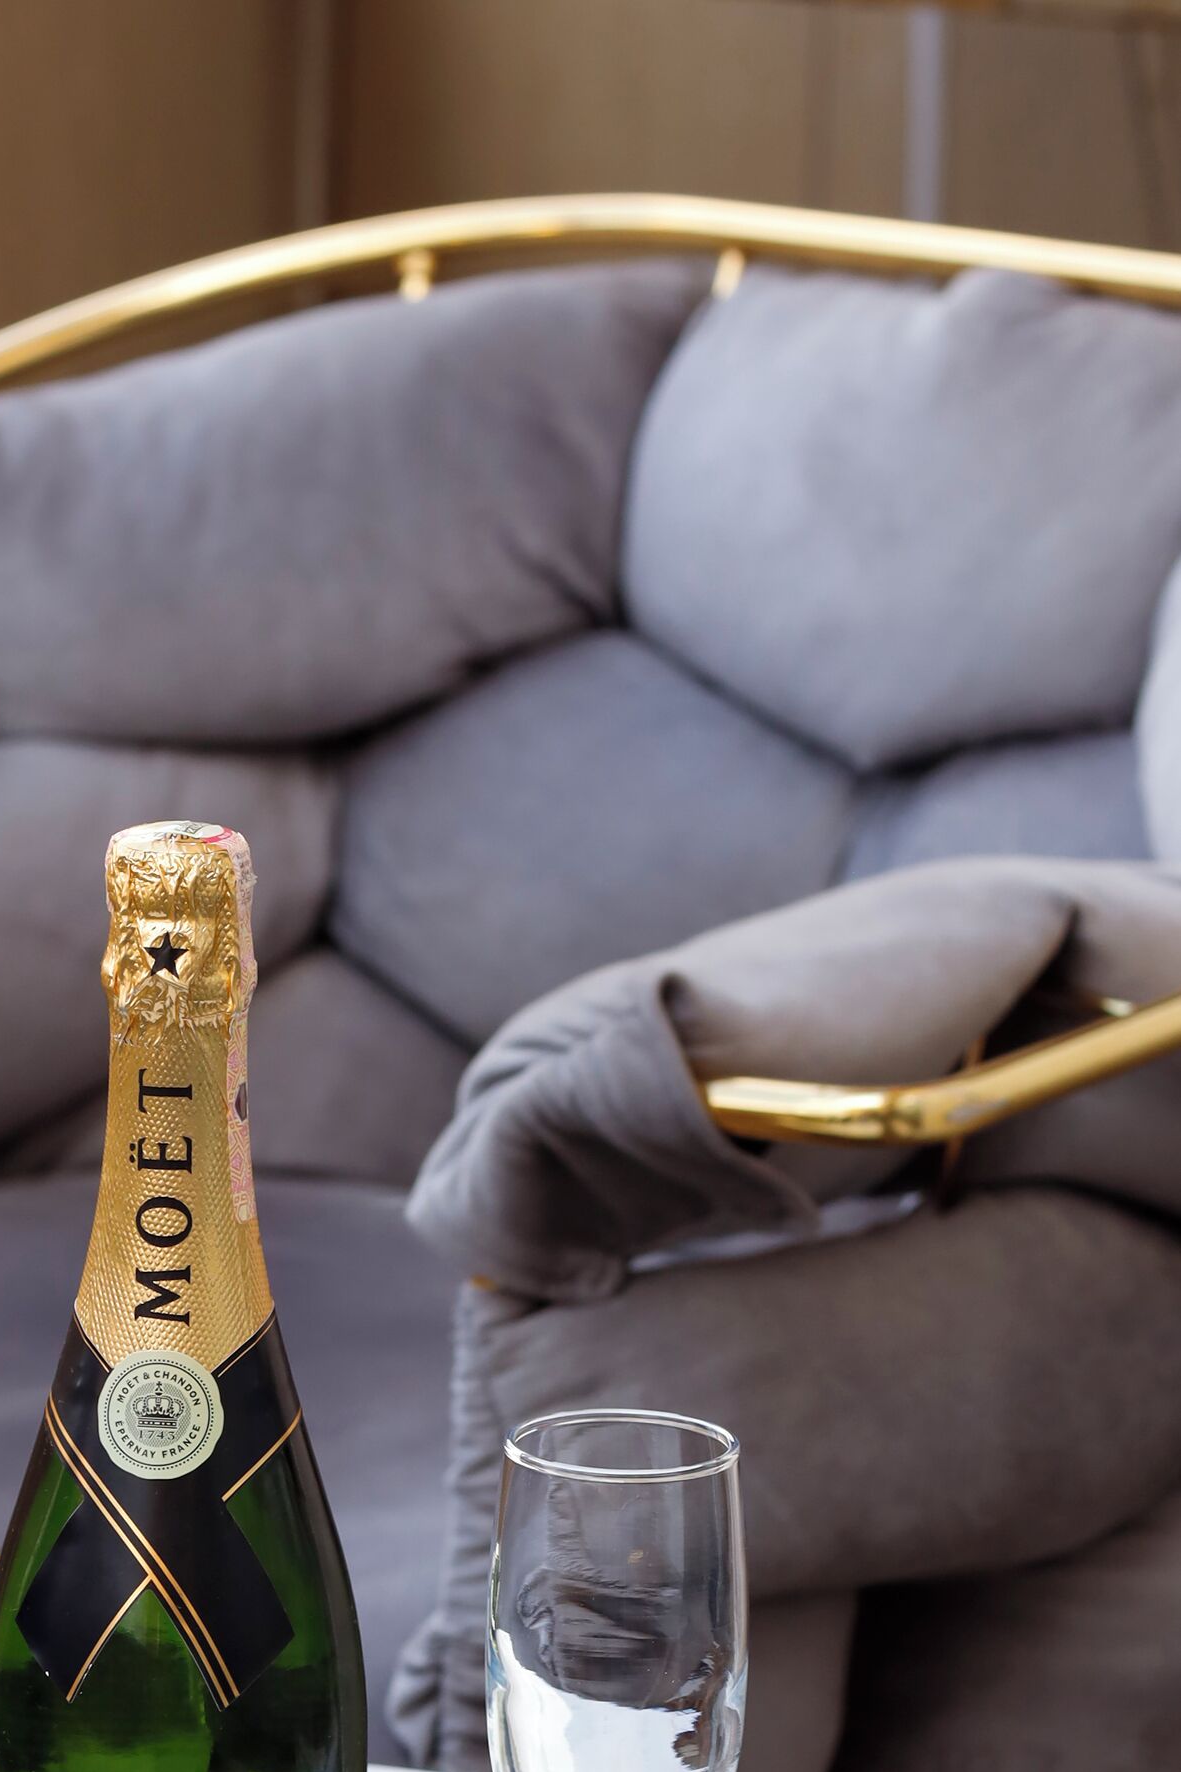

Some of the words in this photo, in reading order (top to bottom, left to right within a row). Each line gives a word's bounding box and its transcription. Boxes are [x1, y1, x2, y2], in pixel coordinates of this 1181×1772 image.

[128, 1067, 194, 1328] MOËT
[142, 1371, 151, 1380] &
[154, 1370, 201, 1407] CHANDON
[162, 1424, 201, 1459] FRANCE
